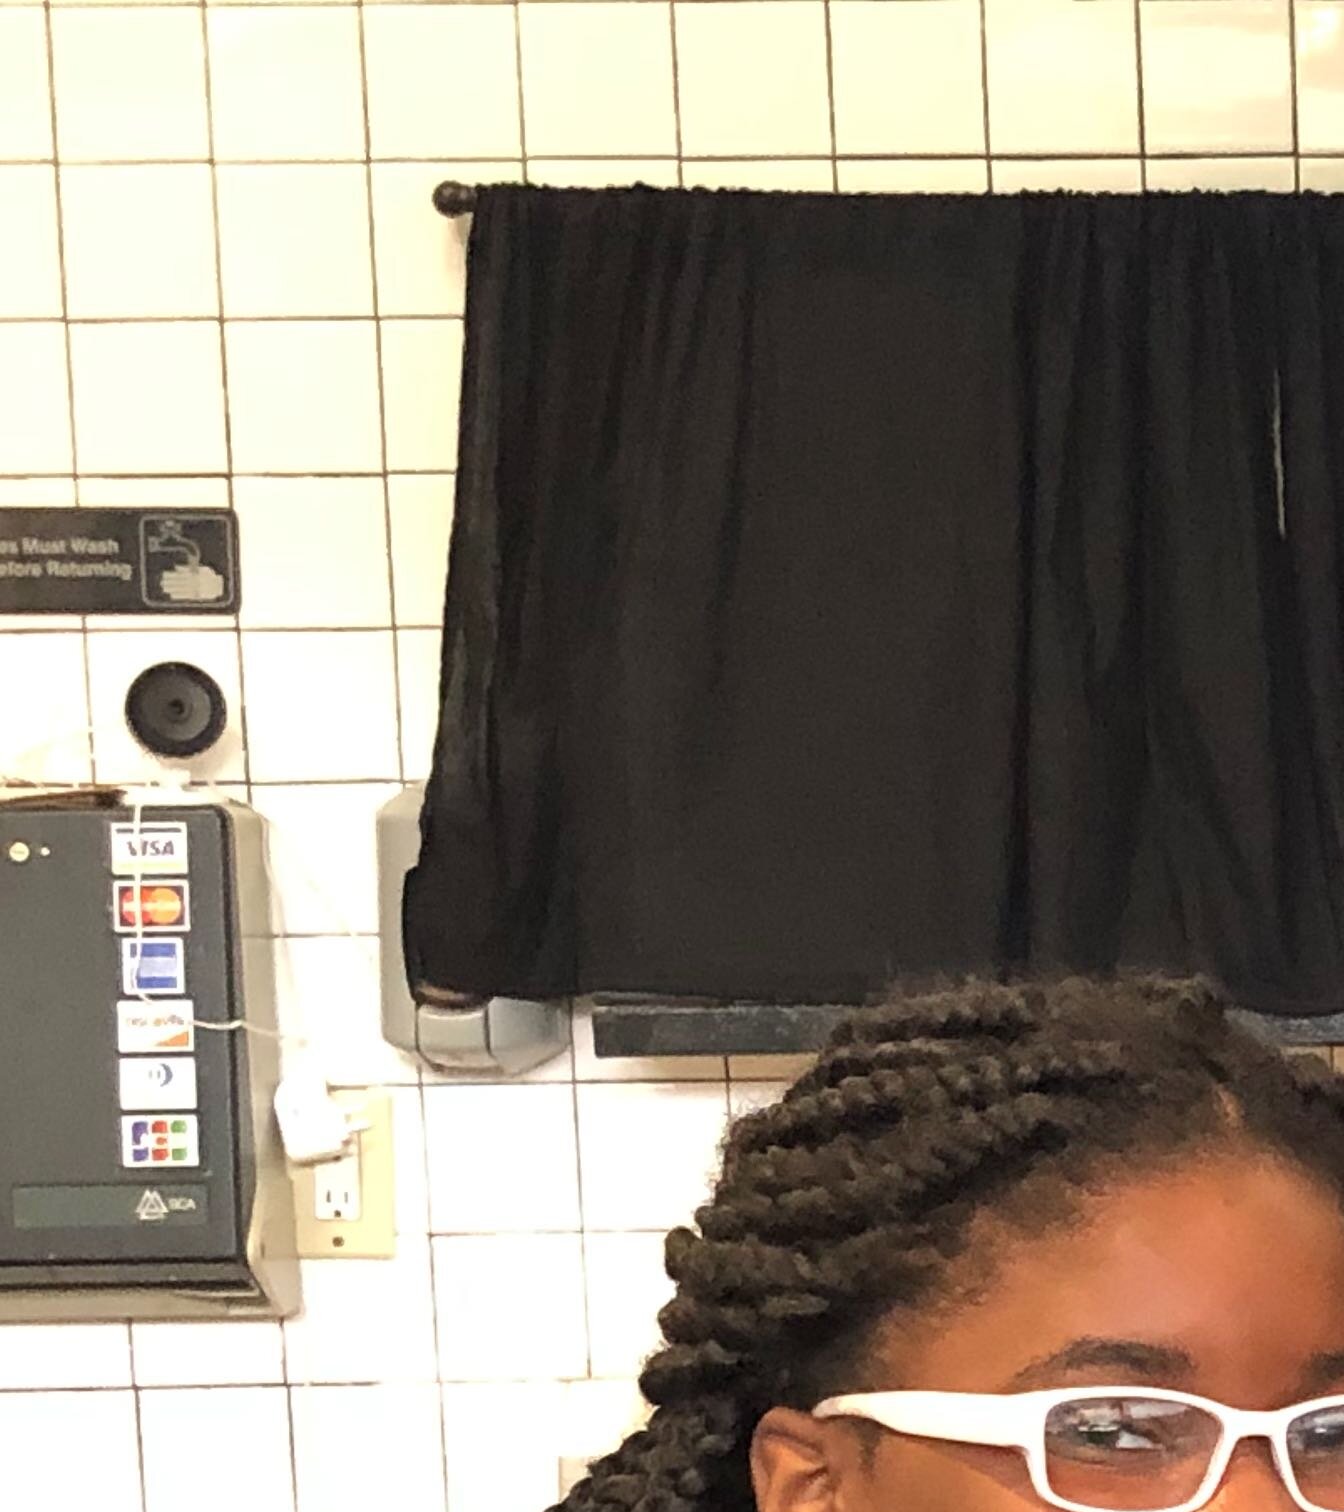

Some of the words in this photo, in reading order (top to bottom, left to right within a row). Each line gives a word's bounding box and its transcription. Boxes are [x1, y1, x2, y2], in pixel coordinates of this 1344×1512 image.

[22, 537, 66, 554] Must
[70, 536, 119, 554] Wash
[46, 560, 132, 581] Returning
[126, 840, 175, 857] VISA
